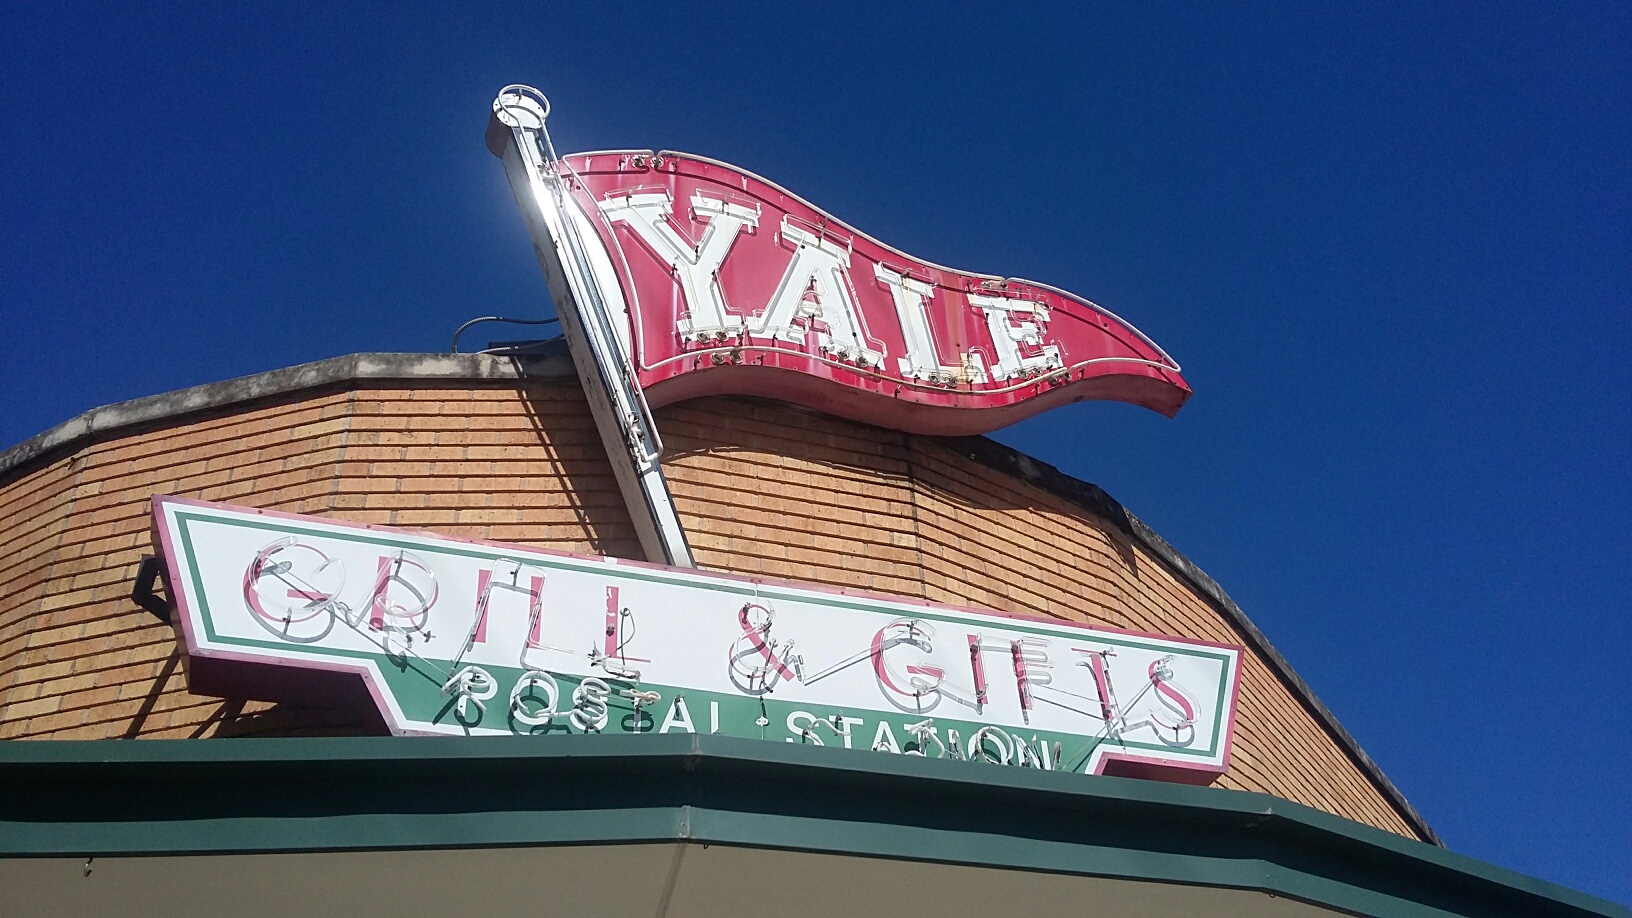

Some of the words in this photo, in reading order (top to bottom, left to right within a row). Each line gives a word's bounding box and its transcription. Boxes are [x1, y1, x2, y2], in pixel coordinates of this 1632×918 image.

[597, 185, 1067, 388] YALE
[728, 601, 796, 686] &
[869, 617, 1201, 732] GIFTS
[784, 709, 1055, 770] STATION
